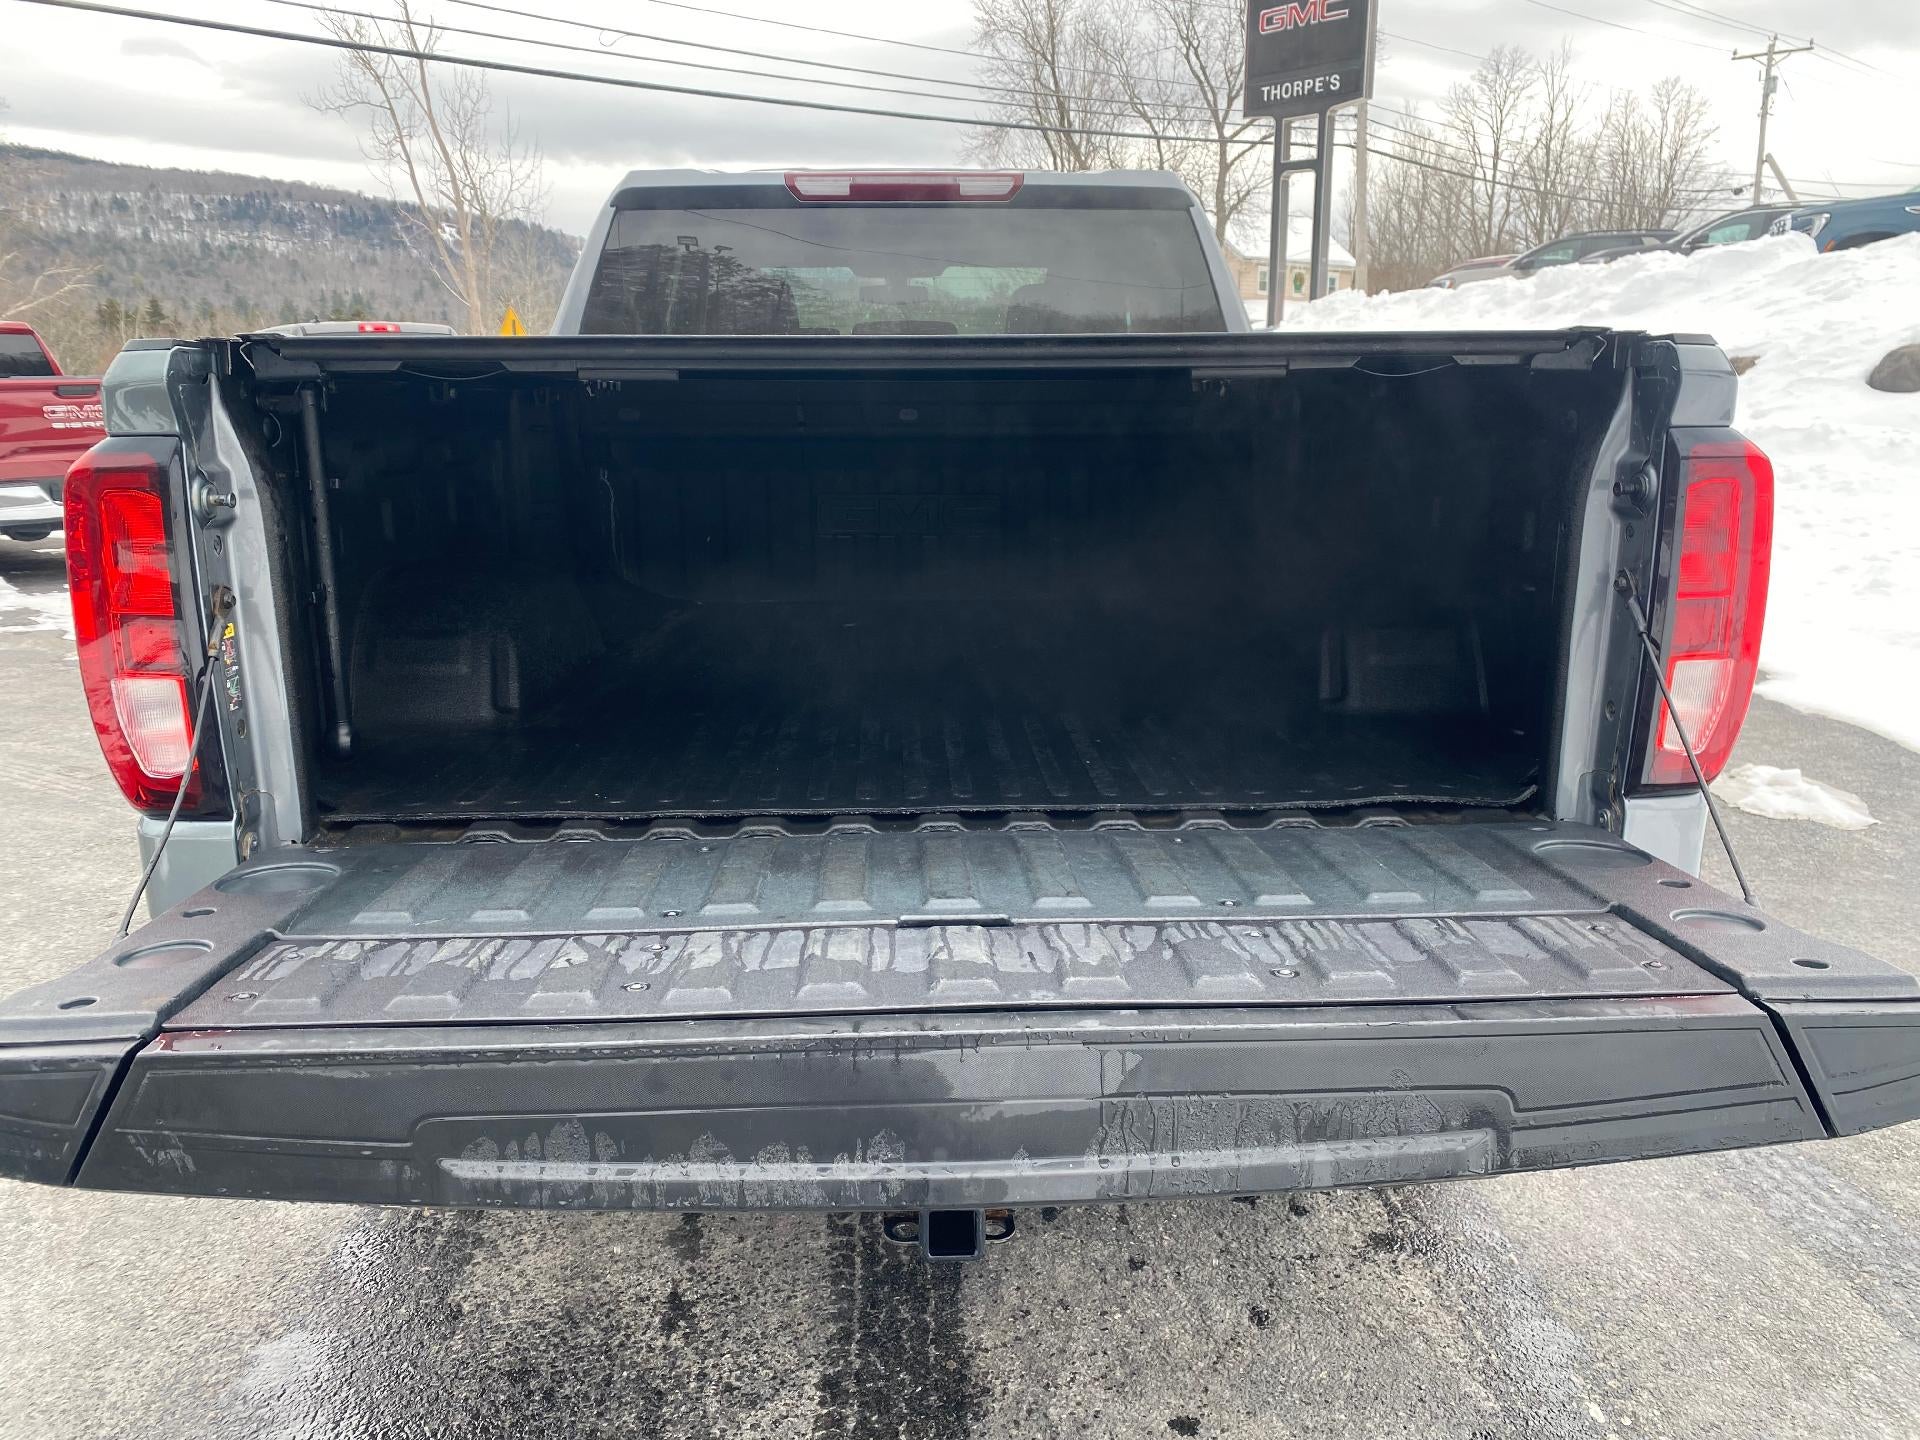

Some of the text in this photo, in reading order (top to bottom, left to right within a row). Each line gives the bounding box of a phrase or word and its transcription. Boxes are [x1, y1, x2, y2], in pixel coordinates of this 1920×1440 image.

[1259, 0, 1349, 34] GMC
[1261, 74, 1341, 102] THORPE'S
[817, 494, 1002, 537] GMC
